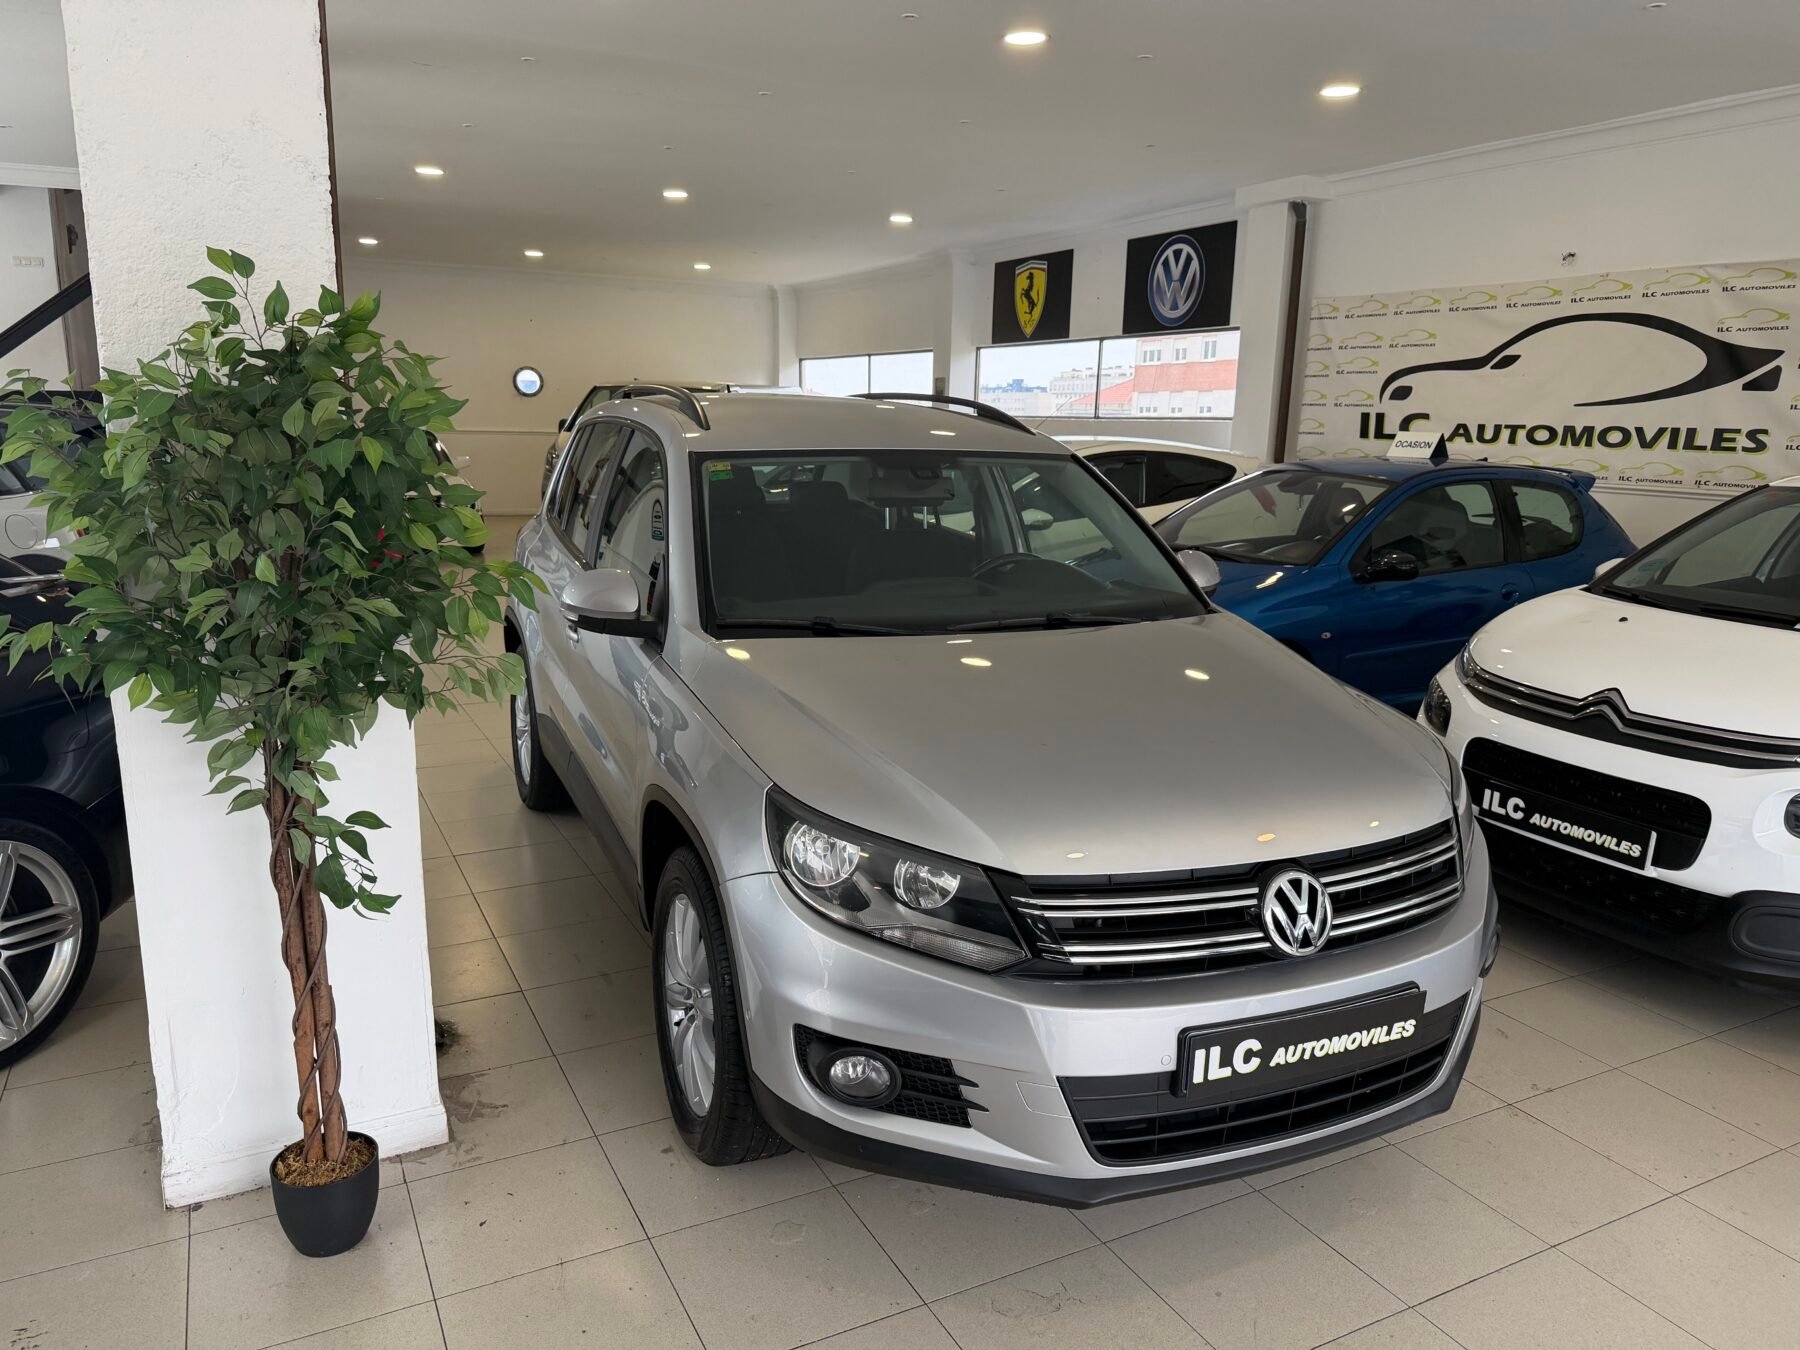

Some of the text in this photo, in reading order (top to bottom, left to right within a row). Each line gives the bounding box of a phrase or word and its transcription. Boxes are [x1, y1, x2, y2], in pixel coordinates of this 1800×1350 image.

[1660, 289, 1710, 297] AUTOMOVILES
[1359, 412, 1769, 453] ILC AUTOMOVILES
[1395, 440, 1433, 449] OCASION
[1482, 788, 1642, 858] ILC AUTOMOVILES
[1192, 1019, 1417, 1084] ILC AUTOMOVILES
